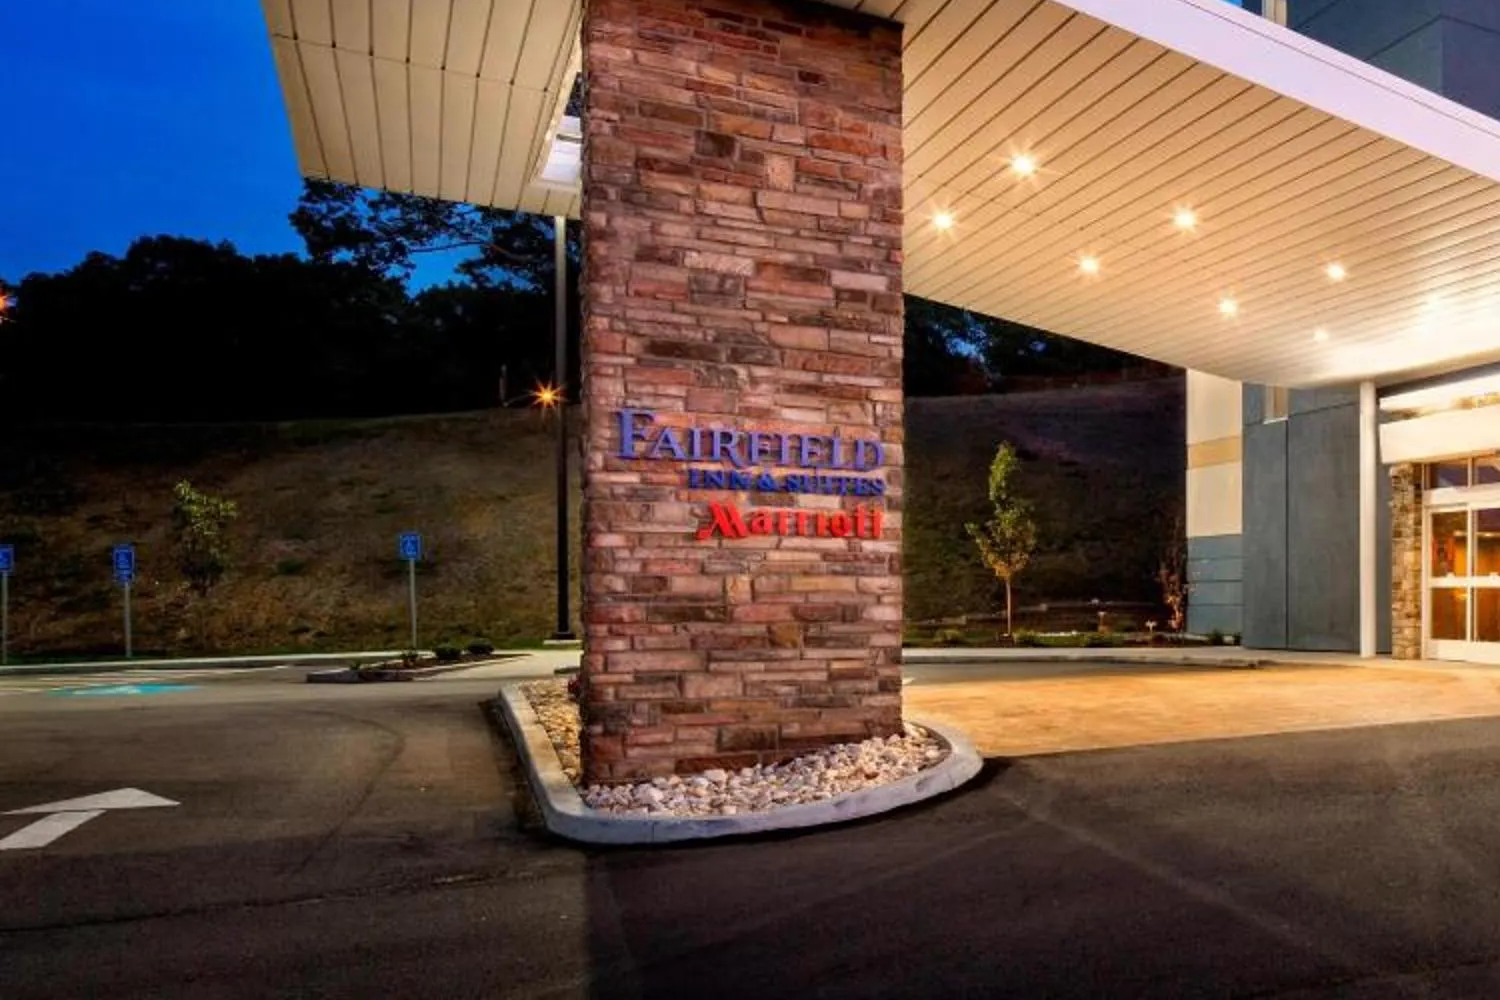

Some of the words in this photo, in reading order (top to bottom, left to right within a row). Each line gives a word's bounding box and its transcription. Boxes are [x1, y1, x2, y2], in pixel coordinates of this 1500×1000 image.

[616, 407, 886, 471] FAIRFIELD
[688, 468, 751, 490] INN
[756, 472, 780, 493] &
[783, 473, 887, 497] SUITES
[695, 501, 886, 542] Marriott
